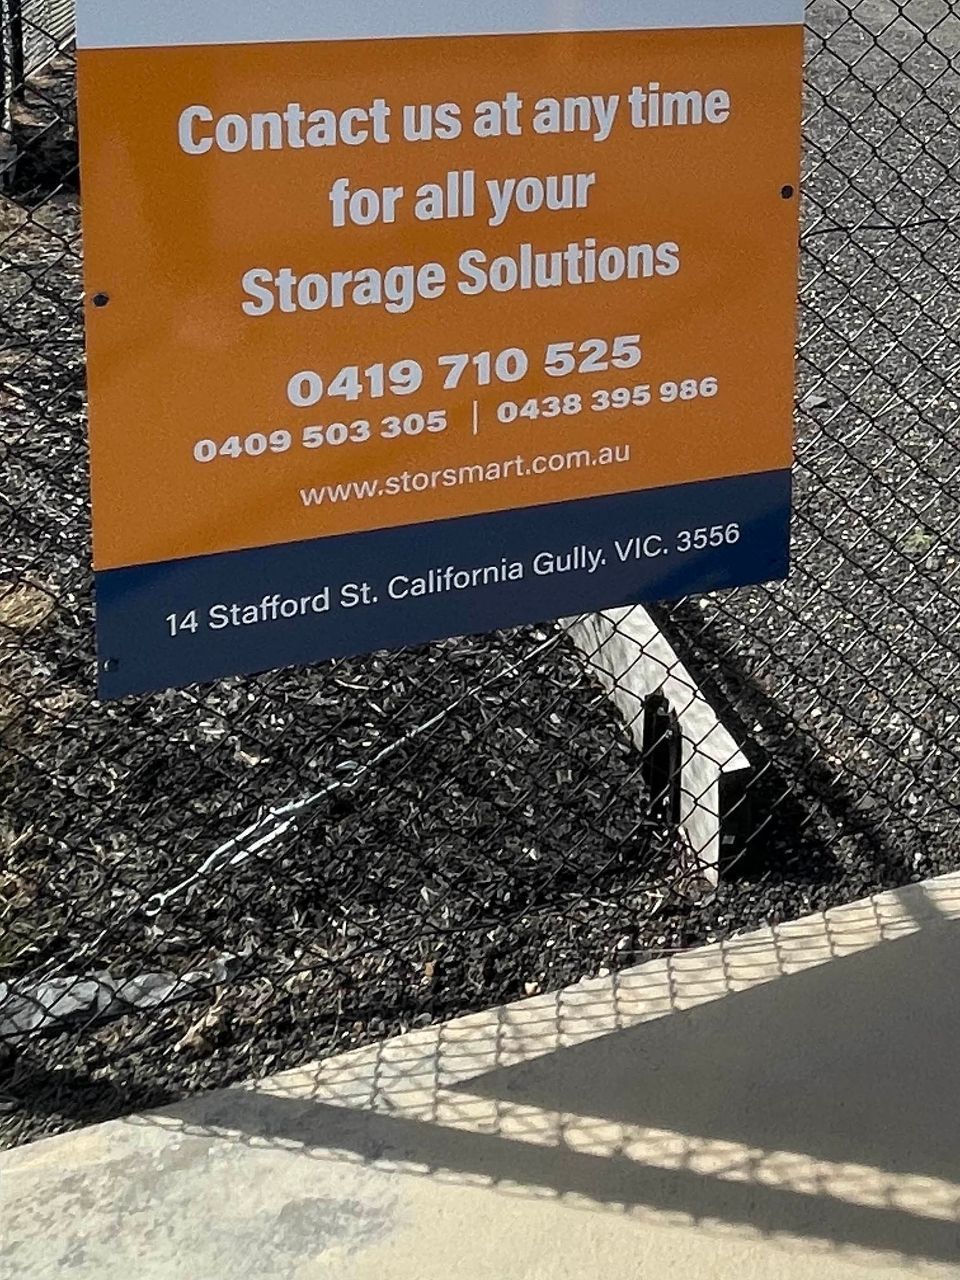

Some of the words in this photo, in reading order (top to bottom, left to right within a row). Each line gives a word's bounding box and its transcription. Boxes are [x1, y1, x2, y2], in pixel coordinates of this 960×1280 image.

[179, 99, 391, 155] Contact
[404, 103, 462, 142] us
[474, 92, 523, 138] at
[533, 95, 620, 142] any
[628, 82, 731, 128] time
[329, 178, 404, 227] for
[415, 170, 475, 221] all
[486, 173, 596, 227] your
[242, 263, 446, 316] Storage
[458, 238, 680, 295] Solutions
[287, 359, 423, 407] 0419
[438, 348, 529, 390] 710
[545, 335, 642, 377] 525
[194, 430, 292, 463] 0409
[303, 421, 371, 449] 503
[381, 411, 447, 439] 305
[497, 394, 582, 423] 0438
[591, 385, 651, 411] 395
[660, 377, 718, 403] 986
[300, 443, 630, 506] www.storsmart.com.au
[167, 611, 199, 636] 14
[210, 587, 330, 629] Stafford
[341, 583, 378, 607] St.
[389, 559, 523, 599] California
[615, 535, 668, 562] VIC.
[677, 524, 740, 552] 3556
